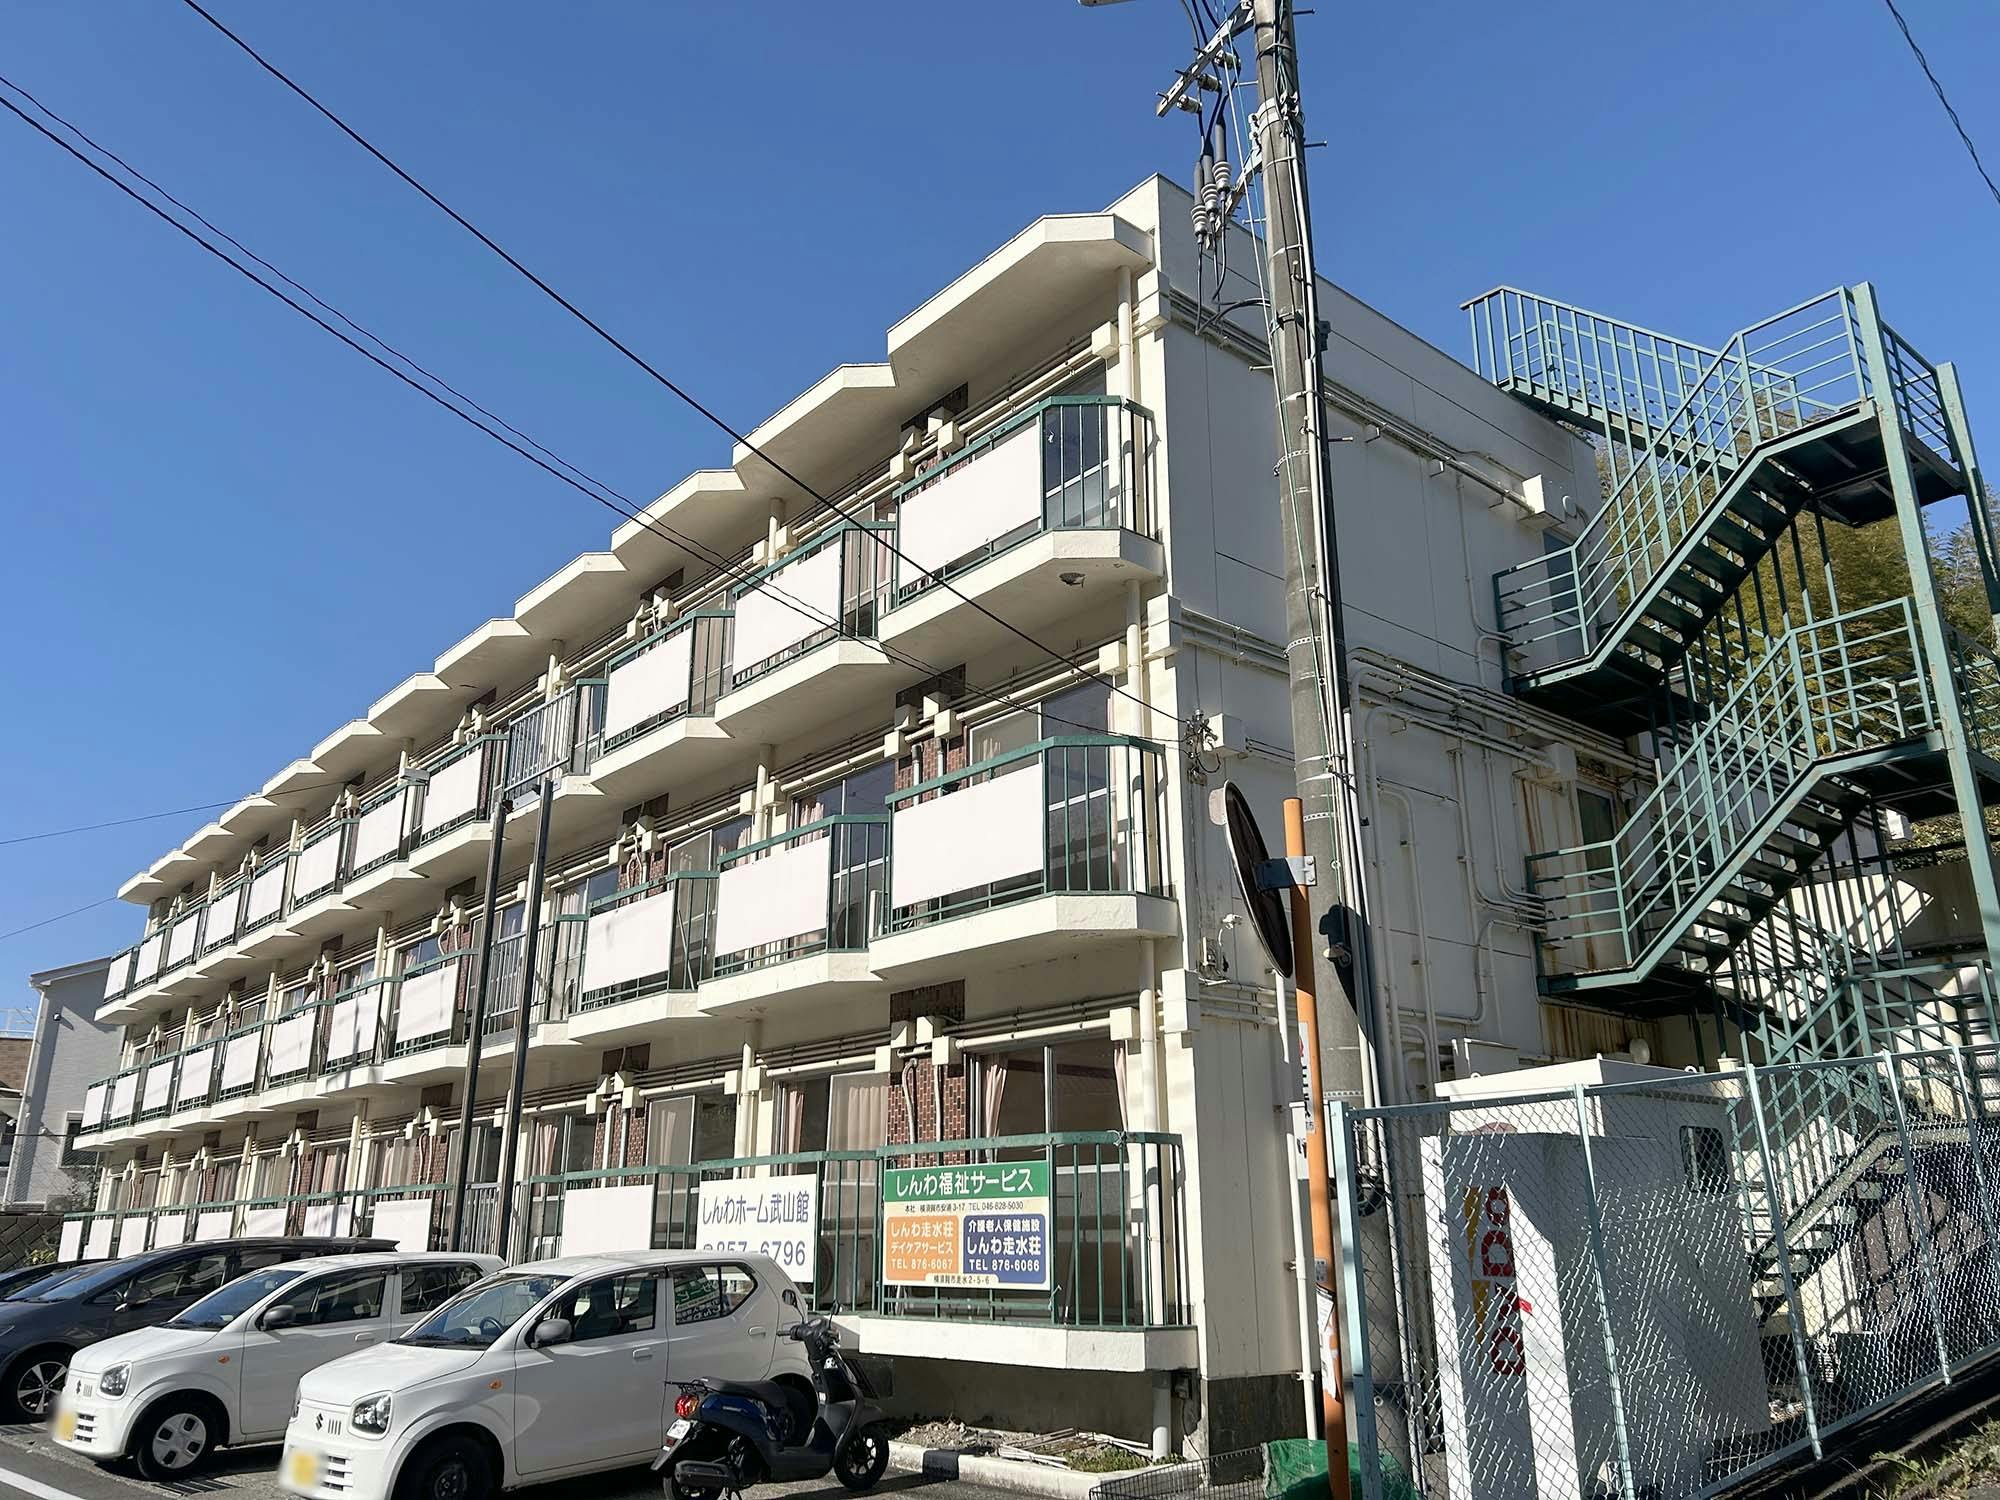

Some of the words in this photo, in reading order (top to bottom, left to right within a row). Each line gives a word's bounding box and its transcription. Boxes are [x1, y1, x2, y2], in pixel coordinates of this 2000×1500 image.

[896, 1168, 1034, 1197] しんわ福祉サービス
[702, 1190, 810, 1225] しんわホーム武山館
[969, 1202, 980, 1211] TEL
[891, 1220, 954, 1237] しんわ走水荘
[968, 1218, 1040, 1233] 介護老人保健施設
[891, 1241, 954, 1254] デイケアサービス
[967, 1235, 1041, 1256] しんわ走水荘
[891, 1258, 908, 1269] TEL
[969, 1258, 988, 1271] TEL
